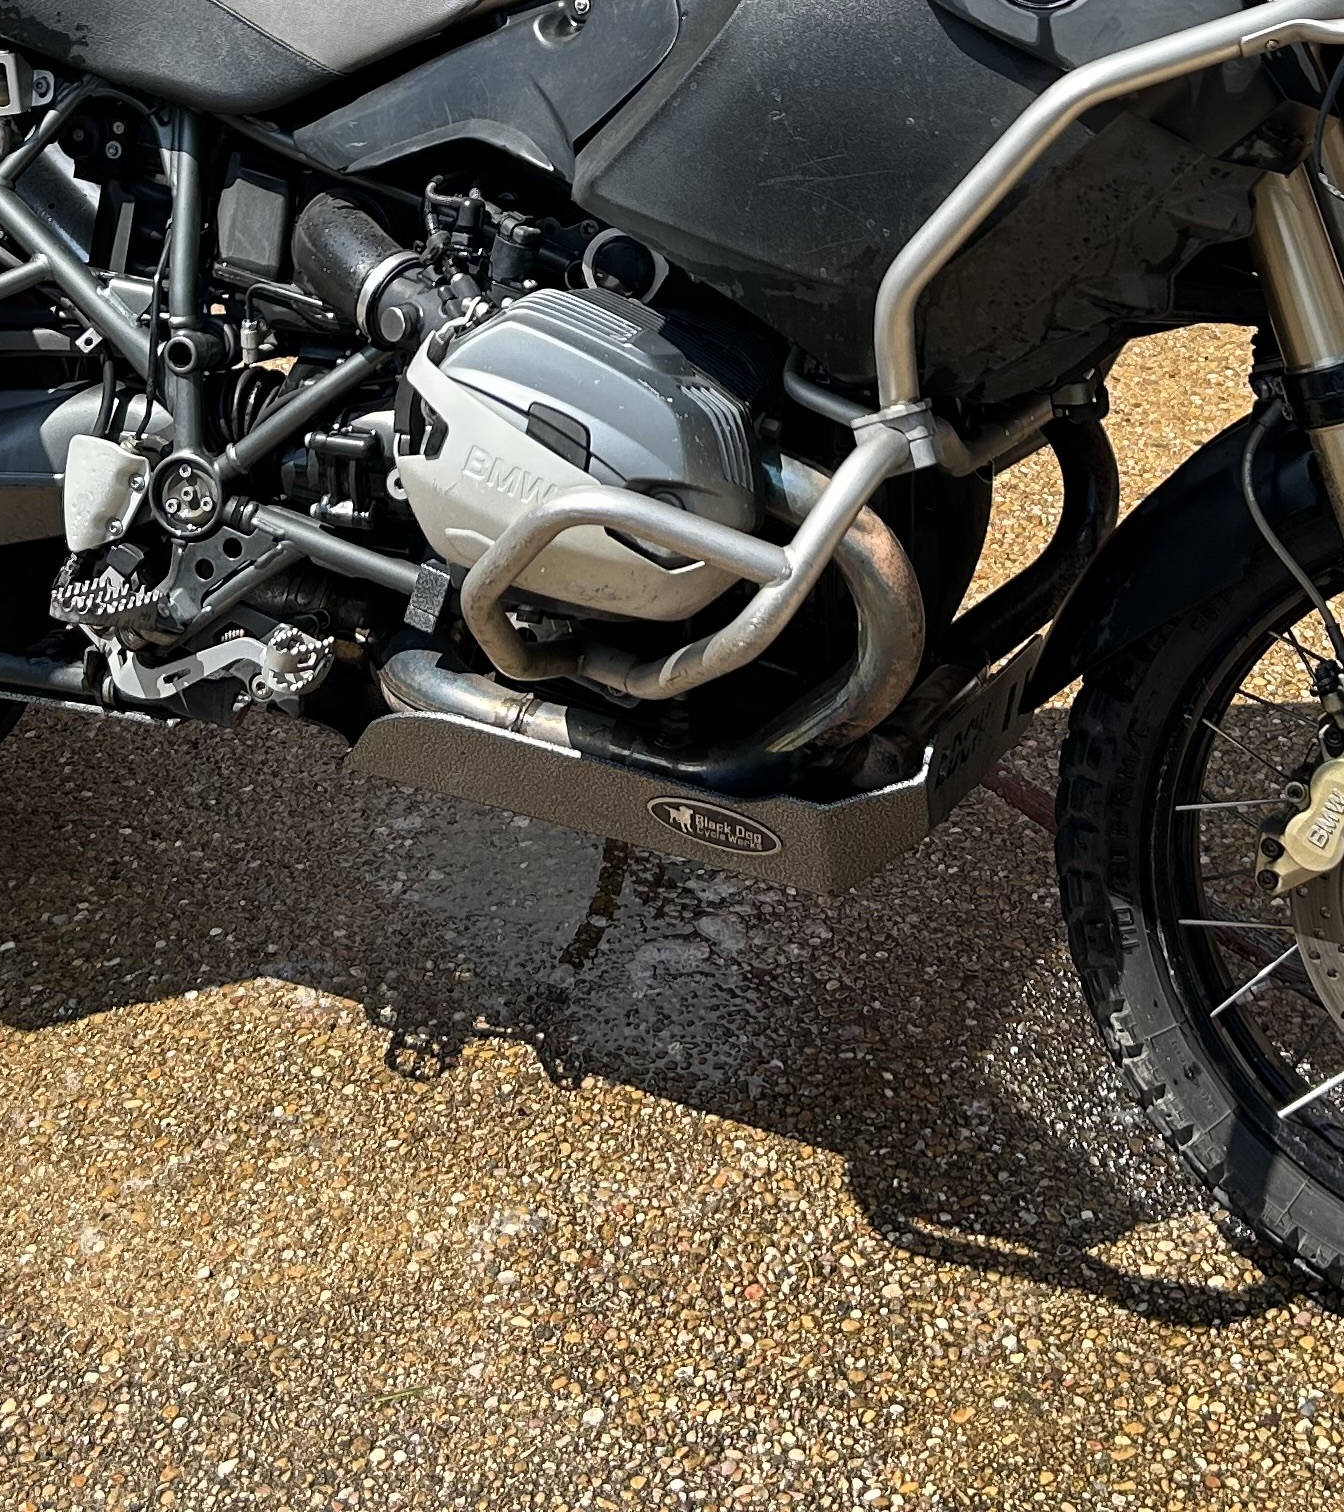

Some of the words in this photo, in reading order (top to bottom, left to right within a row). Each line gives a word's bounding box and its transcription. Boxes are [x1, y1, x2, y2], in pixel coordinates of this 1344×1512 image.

[462, 444, 559, 505] BMW
[696, 814, 731, 834] Black
[736, 825, 762, 845] Dog
